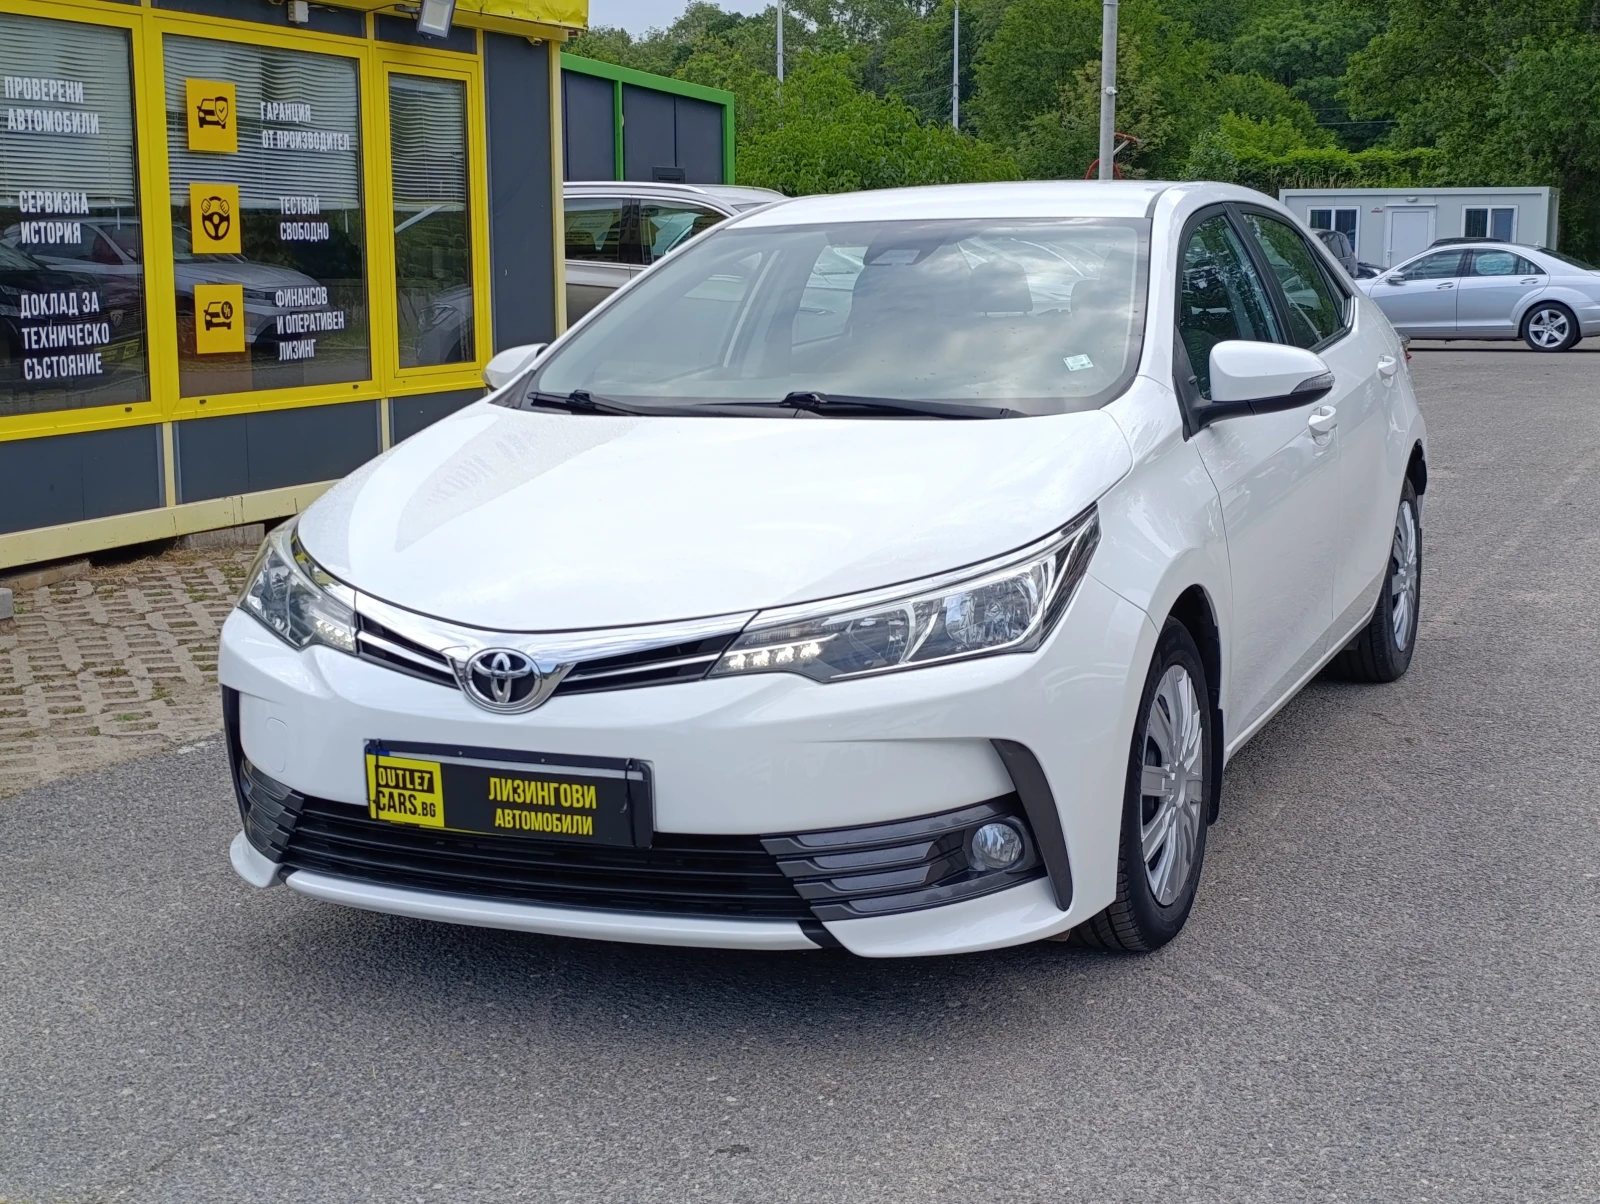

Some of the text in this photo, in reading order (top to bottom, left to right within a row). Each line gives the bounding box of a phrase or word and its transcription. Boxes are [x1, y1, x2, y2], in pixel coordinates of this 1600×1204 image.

[4, 76, 84, 103] ПРОВЕРЕНИ
[7, 108, 100, 134] АВТОМОБИЛИ
[260, 101, 311, 123] ГАРАНЦИЯ
[262, 130, 350, 152] ОТ ПРОИЗВОДИТЕЛ
[19, 190, 89, 214] СЕРВИЗНА
[279, 194, 320, 215] ТЕСТВАЙ
[20, 221, 82, 244] ИСТОРИЯ
[280, 222, 329, 242] СВОБОДНО
[20, 291, 100, 319] ДОКЛАД ЗА
[275, 286, 328, 308] ФИНАНСОВ
[276, 311, 345, 335] И ОПЕРАТИВЕН
[21, 322, 110, 350] ТЕХНИЧЕСКО
[279, 339, 317, 361] ЛИЗИНГ
[24, 353, 103, 381] СЪСТОЯНИЕ
[378, 767, 431, 791] OUTLET
[377, 790, 437, 818] CARS.BG
[488, 777, 597, 809] ЛИЗИНГОВИ
[494, 808, 593, 836] АВТОМОБИЛИ
